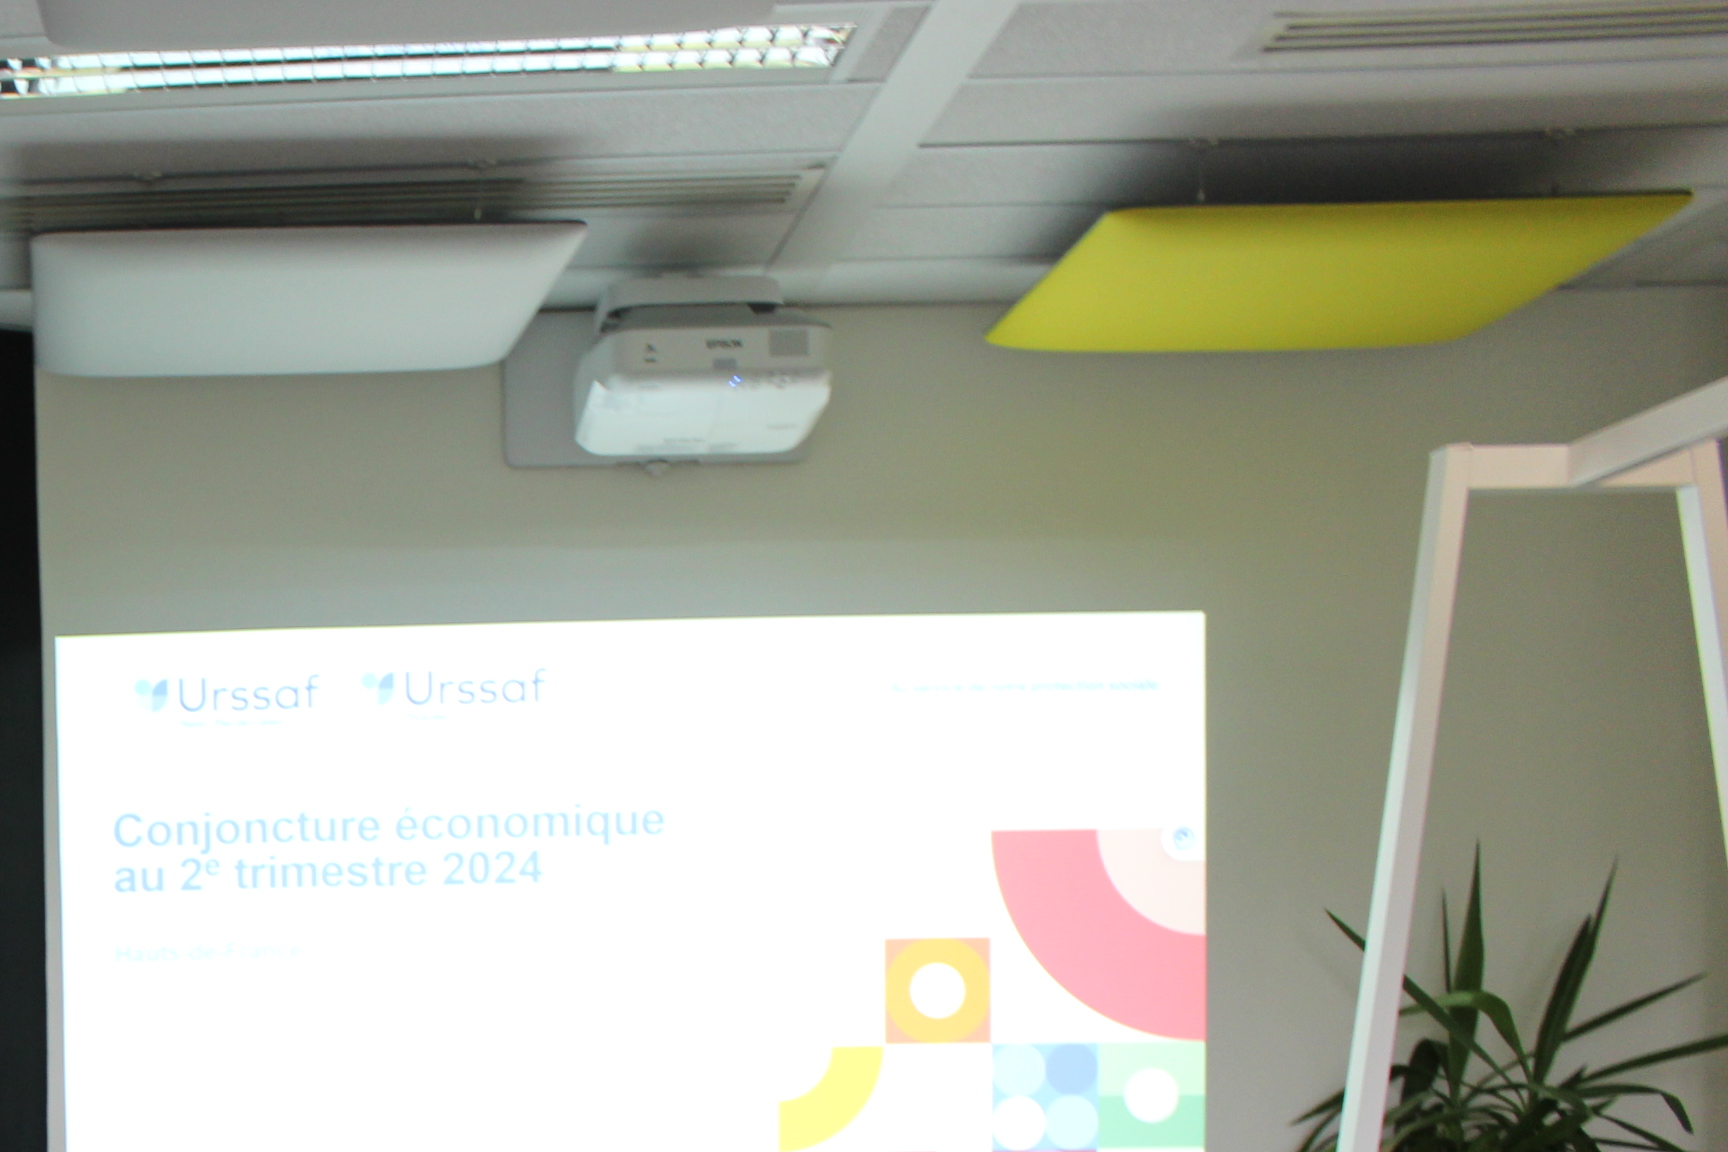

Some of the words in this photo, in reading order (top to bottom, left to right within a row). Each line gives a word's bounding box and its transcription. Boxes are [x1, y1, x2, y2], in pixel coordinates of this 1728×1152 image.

[178, 674, 320, 712] Urssaf
[404, 667, 547, 705] Urssaf
[113, 810, 381, 856] Conjoncture
[394, 802, 665, 846] économique
[113, 866, 165, 893] au
[233, 855, 428, 889] trimestre
[443, 850, 543, 886] 2024
